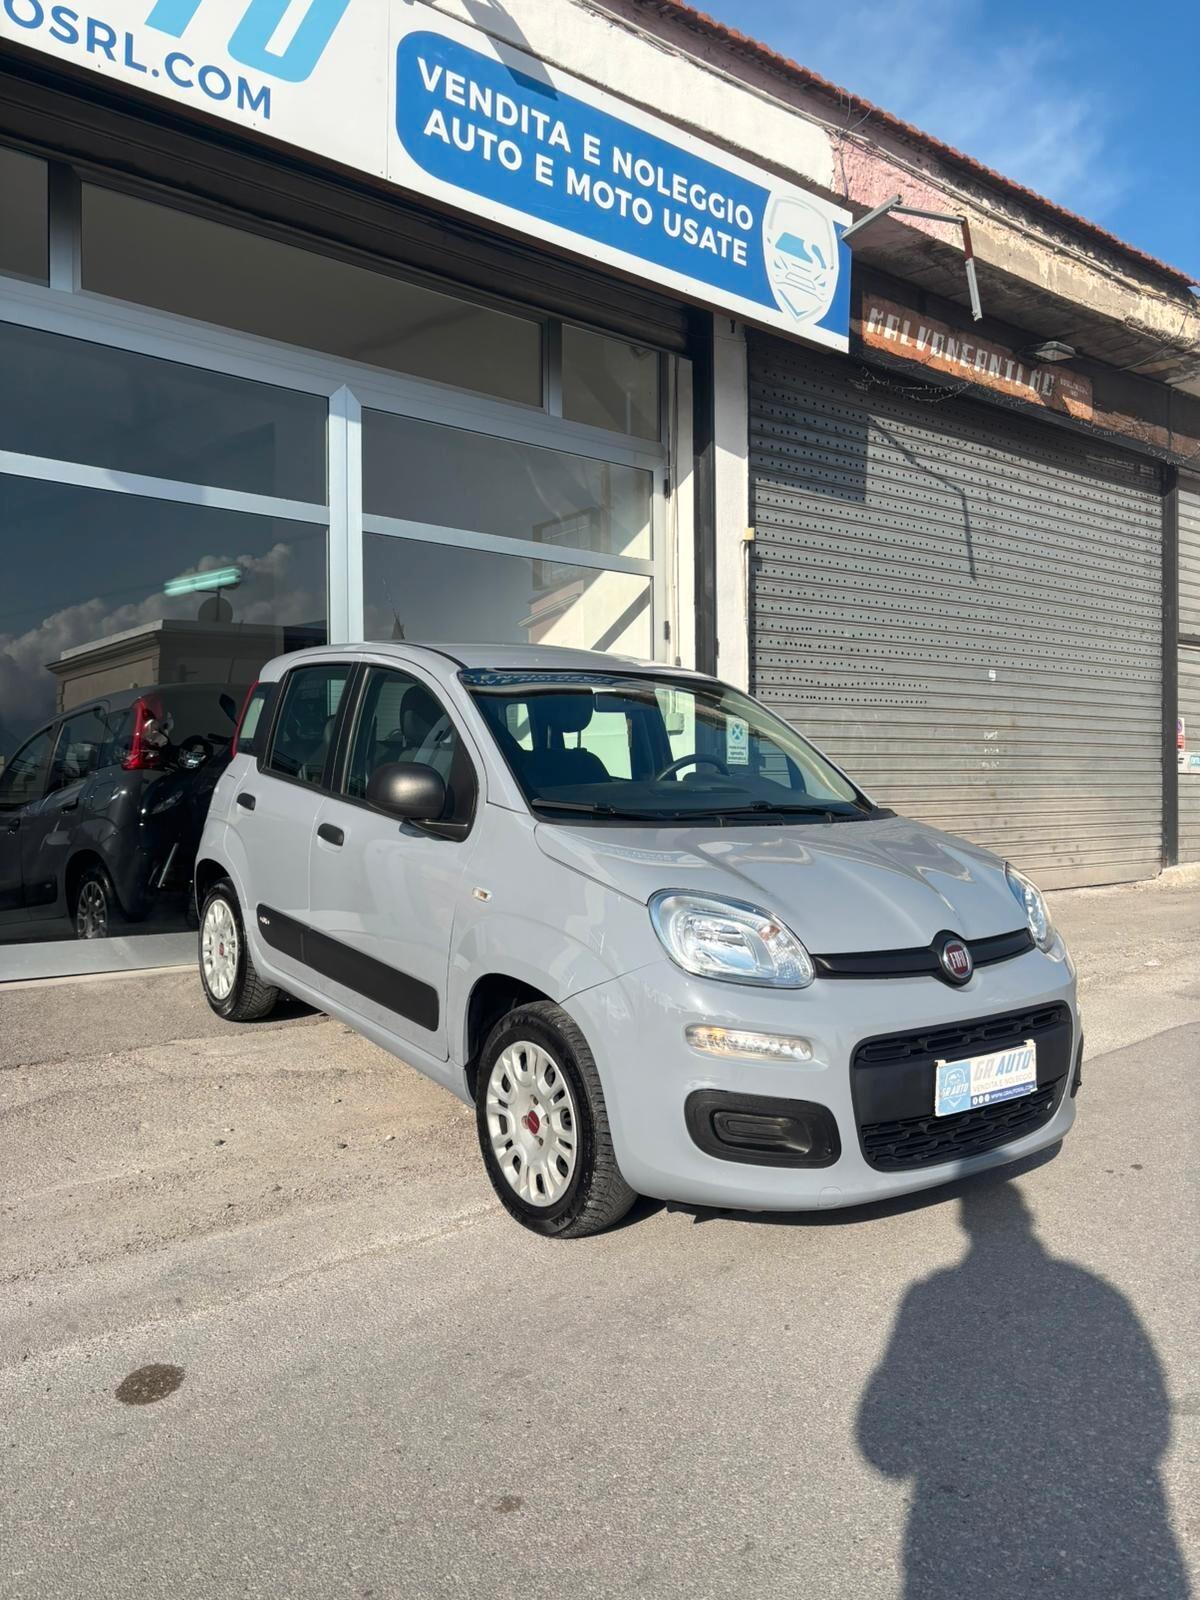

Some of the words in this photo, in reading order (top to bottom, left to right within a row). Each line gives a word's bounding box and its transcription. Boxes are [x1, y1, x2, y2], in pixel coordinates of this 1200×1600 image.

[3, 0, 272, 120] OSRL.COM
[417, 56, 571, 154] VENDITA
[583, 133, 601, 166] E
[612, 146, 754, 231] NOLEGGIO
[423, 109, 523, 172] AUTO
[535, 153, 555, 187] E
[566, 166, 653, 226] MOTO
[663, 208, 748, 268] USATE
[973, 1057, 996, 1081] GR
[995, 1049, 1034, 1077] AUTO
